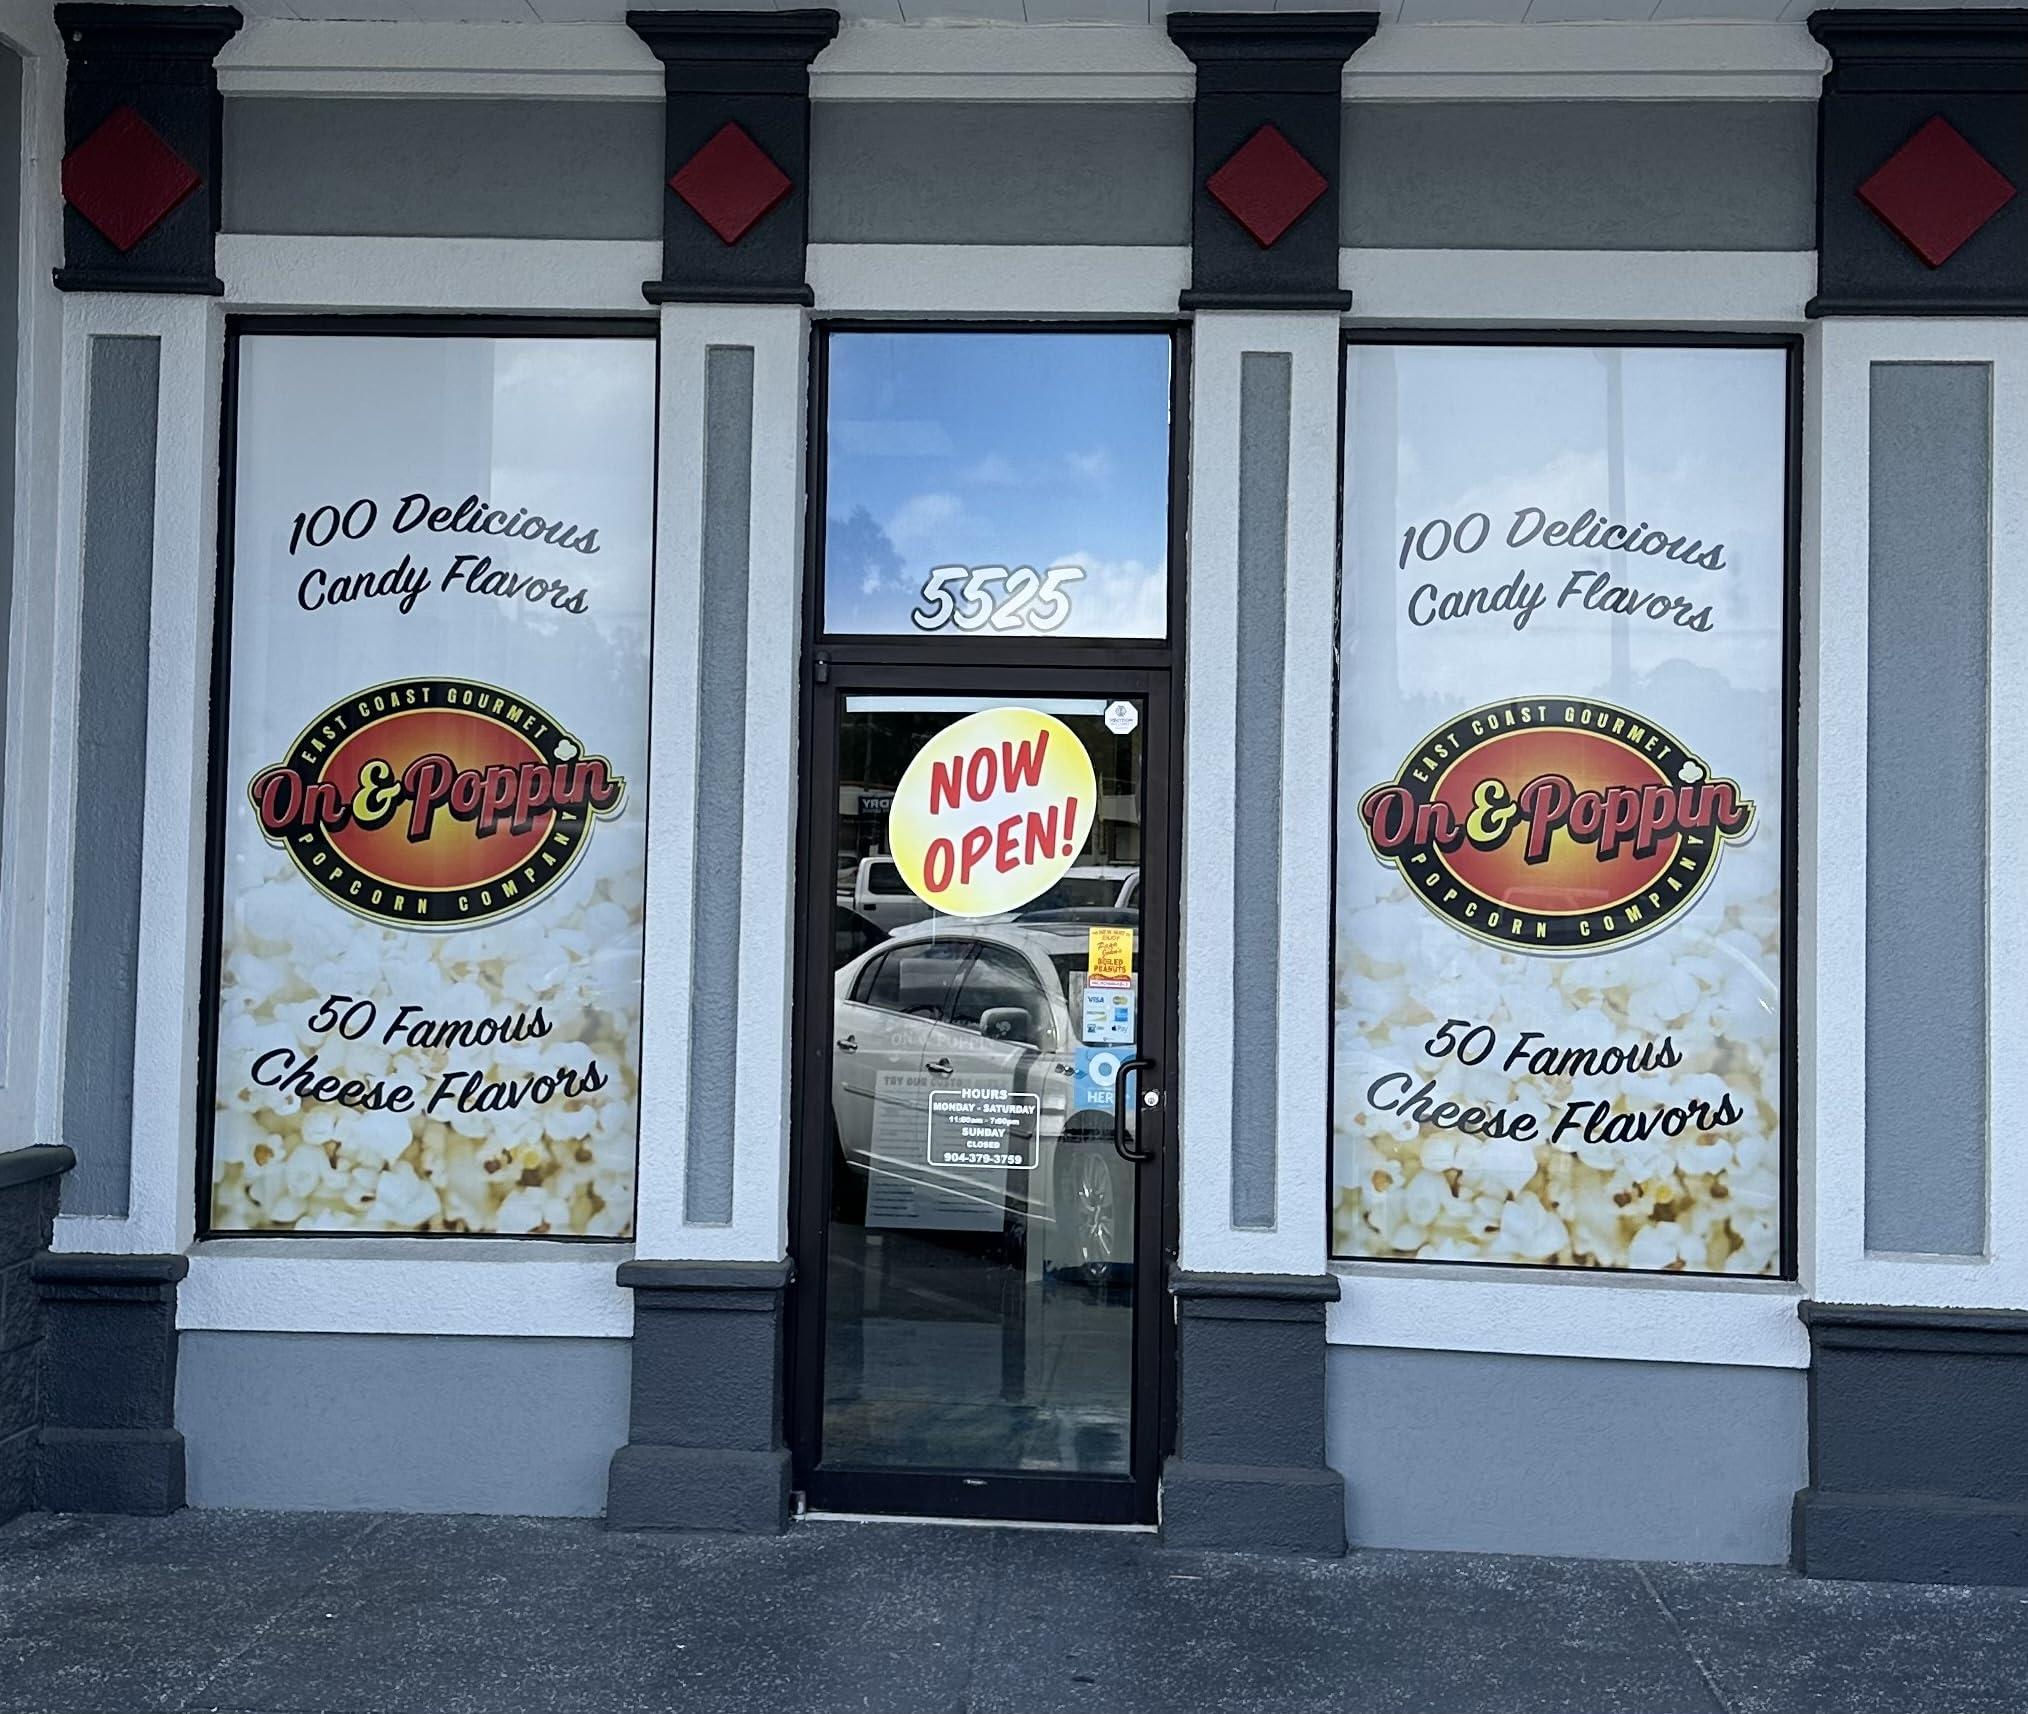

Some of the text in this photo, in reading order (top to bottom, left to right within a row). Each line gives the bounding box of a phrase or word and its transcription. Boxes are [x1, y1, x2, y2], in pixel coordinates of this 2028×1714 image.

[289, 493, 602, 556] 100 Delicious
[1399, 507, 1726, 571] 100 Delicious
[297, 553, 590, 615] Candy Flavors
[911, 564, 1087, 632] 5525
[1407, 569, 1714, 632] Candy Flavors
[301, 686, 550, 763] EAST COAST GOURMET
[1411, 704, 1672, 783] EAST COAST GOURMET
[250, 753, 614, 844] On & Poppin
[929, 729, 1050, 815] NOW
[923, 796, 1078, 893] OPEN!
[1361, 774, 1750, 866] On & Poppin
[298, 810, 580, 914] POPCORN COMPANY
[1411, 833, 1704, 938] POPCORN COMPANY
[308, 994, 553, 1049] 50 Famous
[1088, 996, 1104, 1004] VISA
[1424, 1018, 1683, 1077] 50 Famous
[251, 1048, 609, 1115] Cheese Flavors
[933, 1102, 975, 1112] MONDAY
[983, 1104, 1035, 1115] SATURDAY
[961, 1088, 1008, 1100] HOURS
[1366, 1072, 1744, 1144] Cheese Flavors
[943, 1152, 1023, 1165] 904-379-3759
[961, 1127, 1006, 1138] SUNDAY
[966, 1140, 1000, 1149] CLOSED
